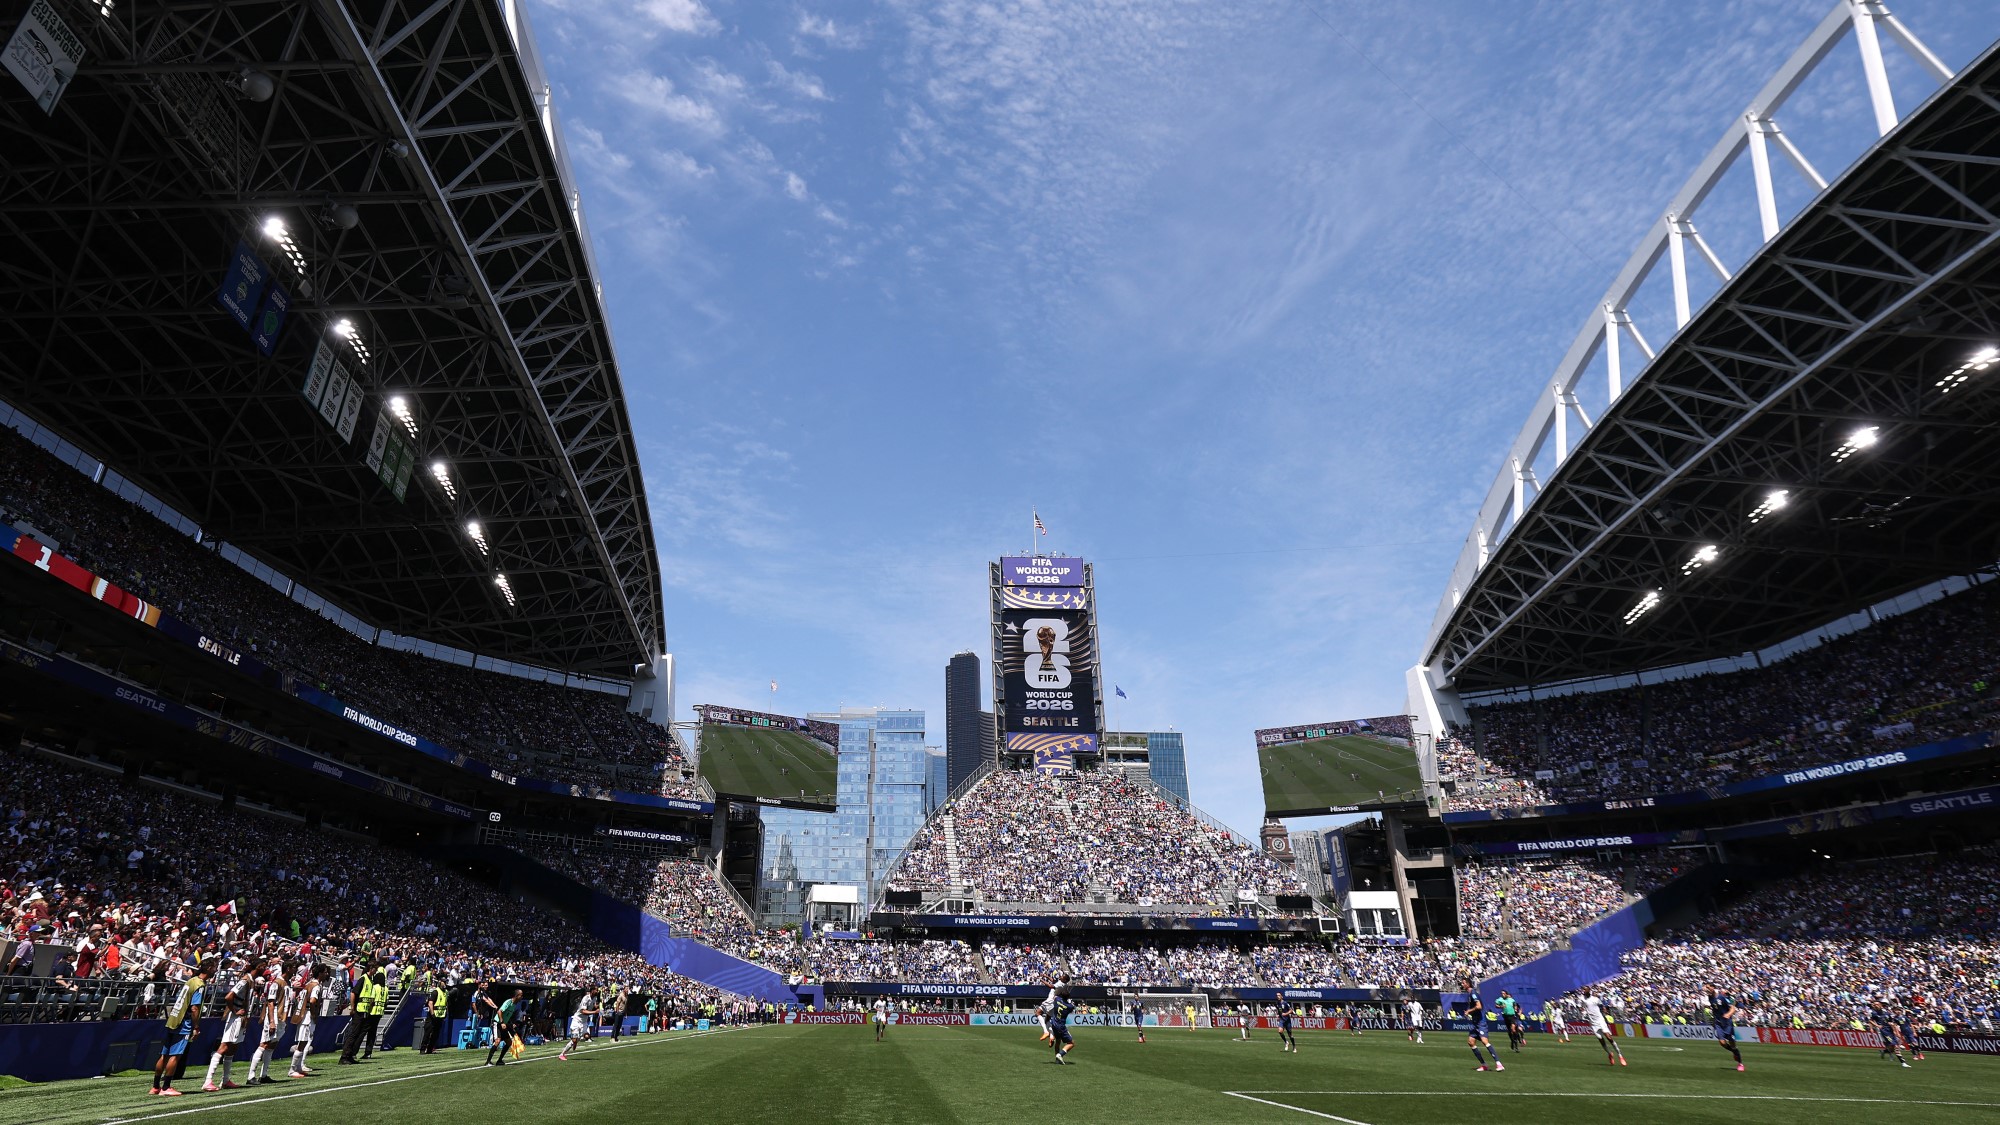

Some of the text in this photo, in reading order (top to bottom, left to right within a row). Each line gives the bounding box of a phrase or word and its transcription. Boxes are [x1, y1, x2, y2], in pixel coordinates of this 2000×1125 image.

[31, 6, 78, 64] CHAMPIONS
[36, 0, 83, 56] 2013 WORLD
[18, 35, 35, 56] SUPER
[11, 52, 40, 86] CHAMPIONS
[34, 545, 52, 571] 1
[198, 636, 241, 666] SEATTLE
[115, 687, 167, 713] SEATTLE
[1026, 700, 1073, 710] 2026
[344, 706, 417, 746] FIFA WORLD CUP 2026
[1023, 717, 1078, 726] SEATTLE
[1783, 752, 1908, 784] FIFA WORLD CUP 2026
[490, 769, 517, 786] SEATTLE
[444, 804, 471, 818] SEATTLE
[1605, 798, 1655, 810] SEATTLE
[1910, 792, 1993, 814] SEATTLE
[623, 830, 646, 838] WORLD
[1517, 836, 1633, 851] FIFA WORLD CUP 2026
[902, 985, 1007, 995] FIFA WORLD CUP 2026
[800, 1014, 863, 1025] ExpressVPN
[903, 1014, 966, 1025] ExpressVPN
[1074, 1015, 1134, 1025] CASAMIGO
[1217, 1017, 1239, 1027] DEPOT
[1304, 1018, 1326, 1028] DEPOT
[1775, 1029, 1885, 1048] THE HOME DEPOT DELIVER
